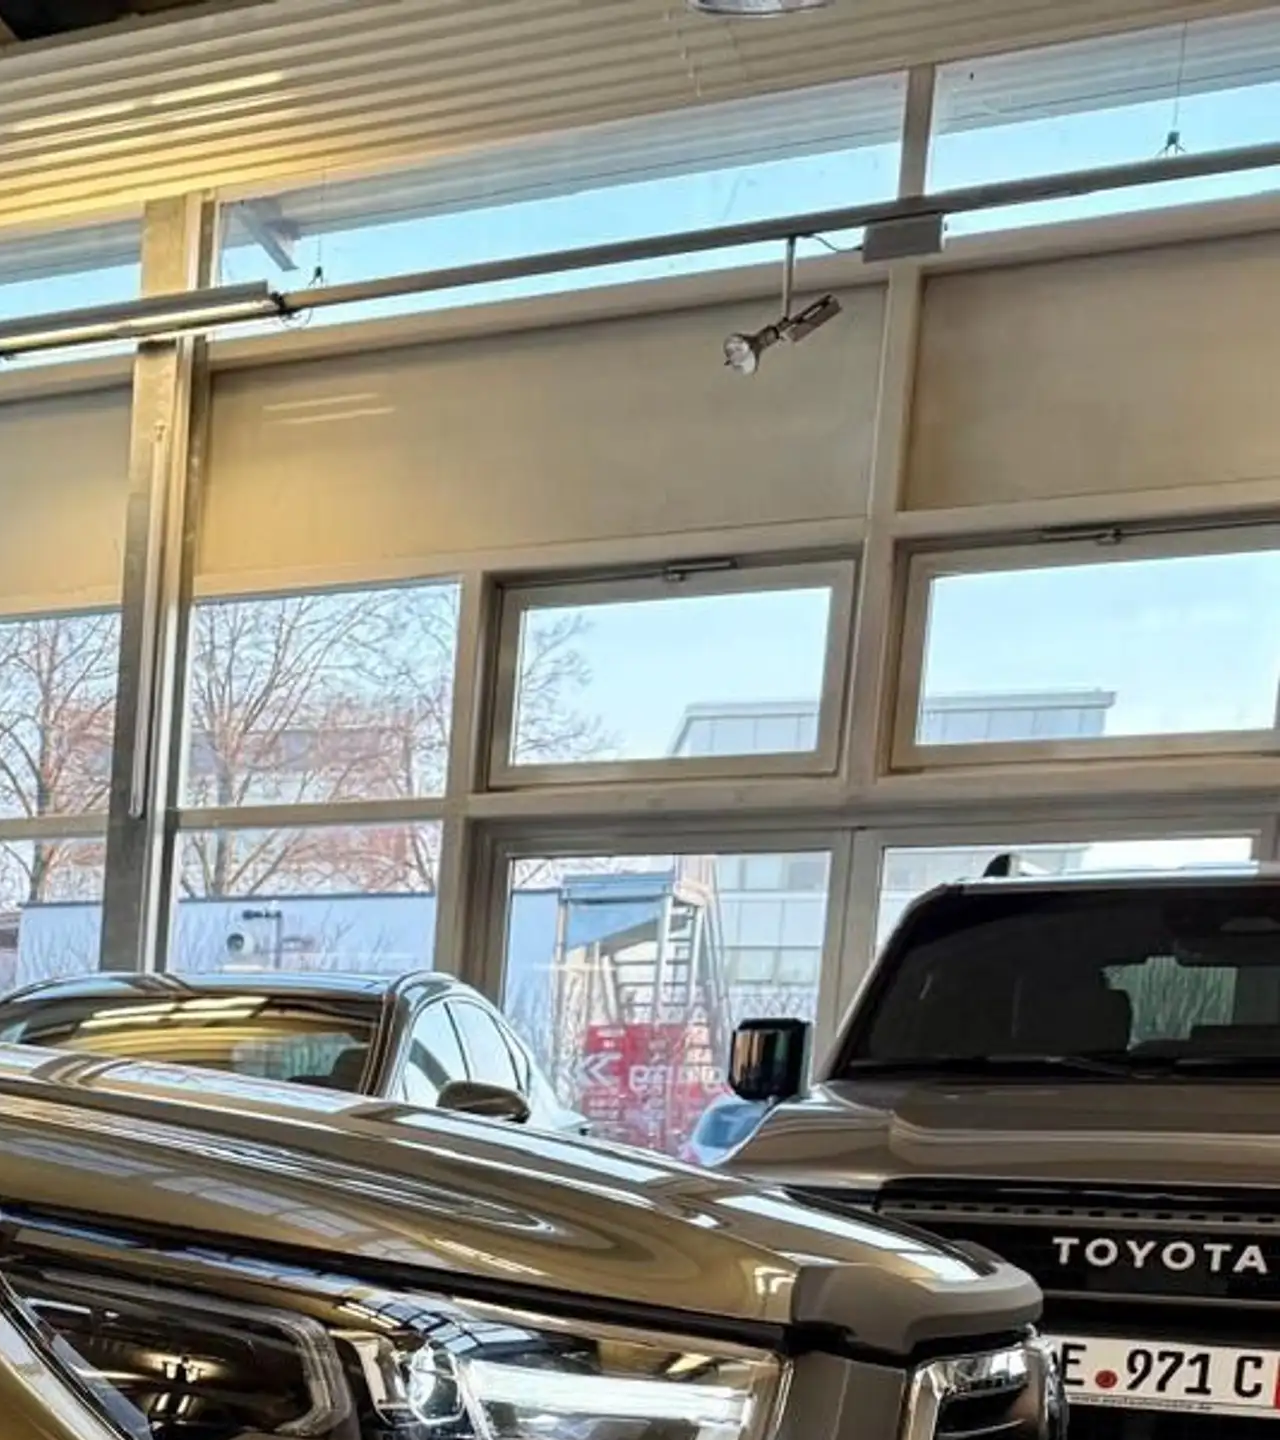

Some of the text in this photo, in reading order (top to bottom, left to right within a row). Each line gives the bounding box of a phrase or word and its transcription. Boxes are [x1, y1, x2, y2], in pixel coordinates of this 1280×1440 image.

[1052, 1236, 1268, 1274] TOYOTA
[1126, 1349, 1211, 1395] 971
[1234, 1356, 1263, 1398] C
